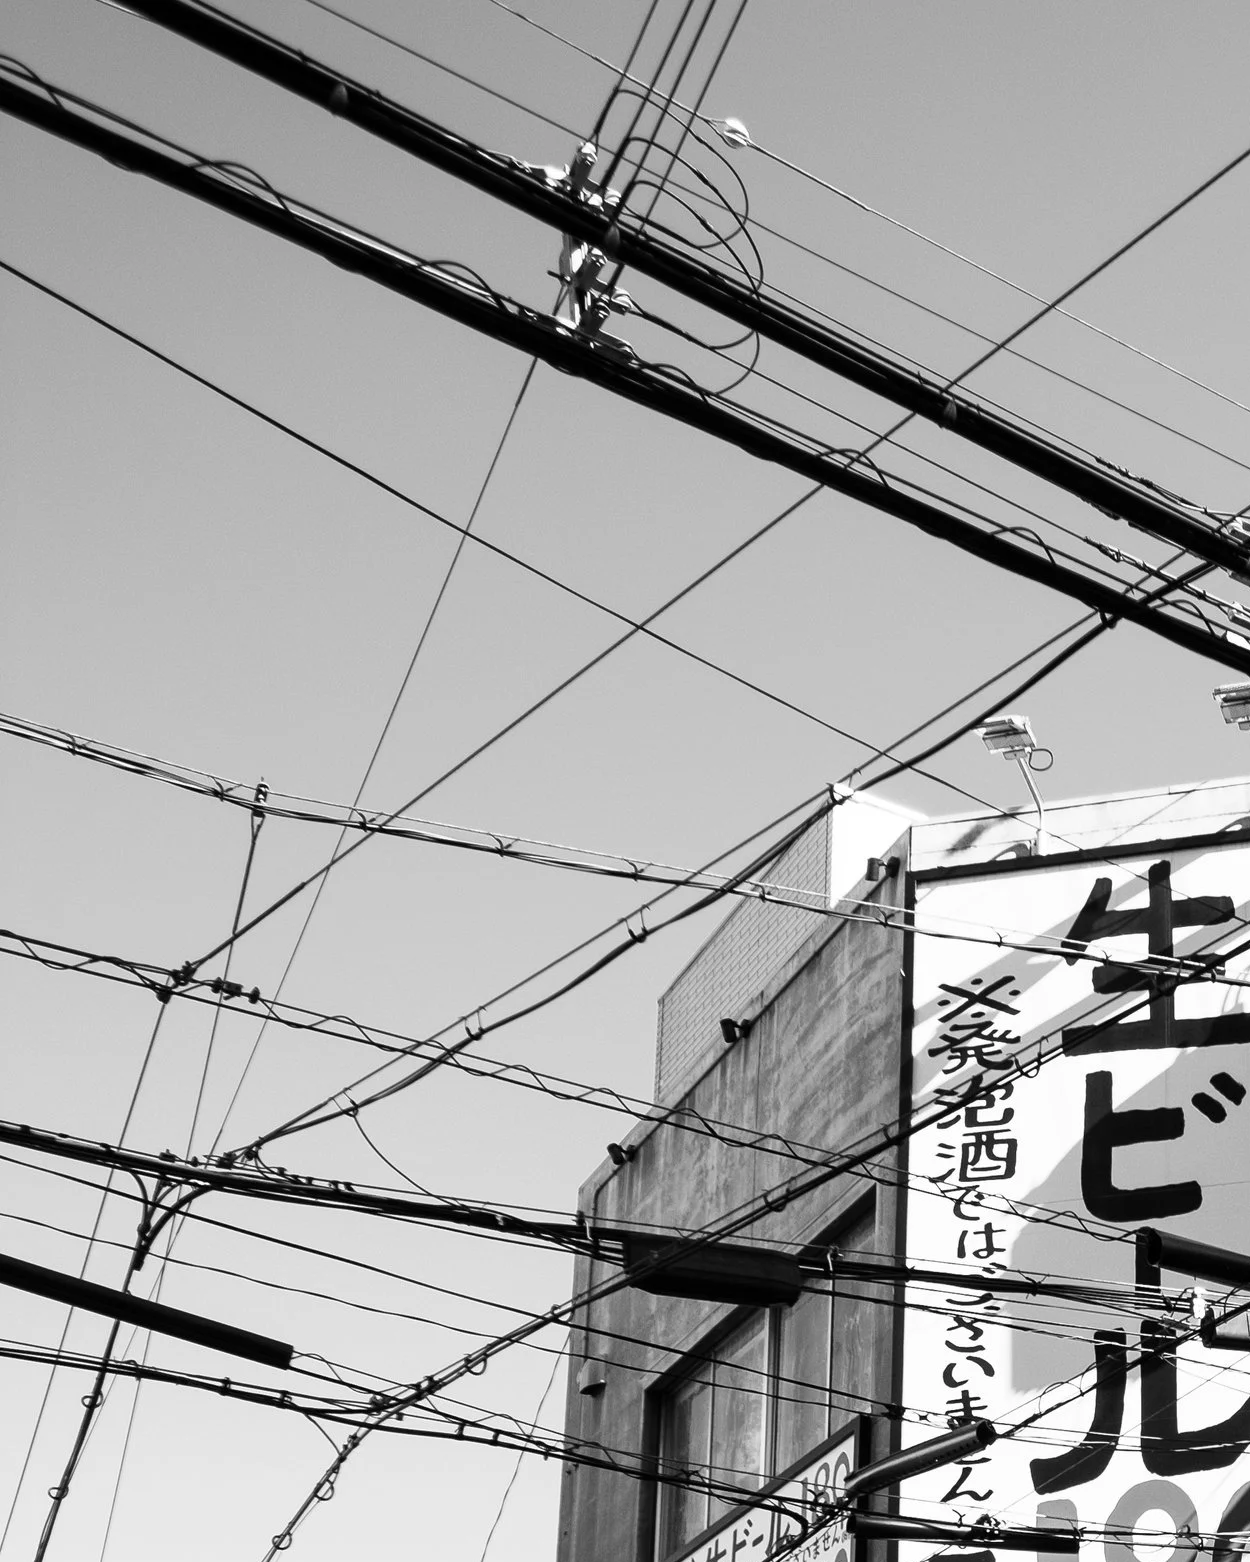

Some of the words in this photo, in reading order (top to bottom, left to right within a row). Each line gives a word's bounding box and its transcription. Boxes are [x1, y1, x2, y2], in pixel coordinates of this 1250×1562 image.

[927, 975, 1021, 1503] ※発泡酒ではございまん
